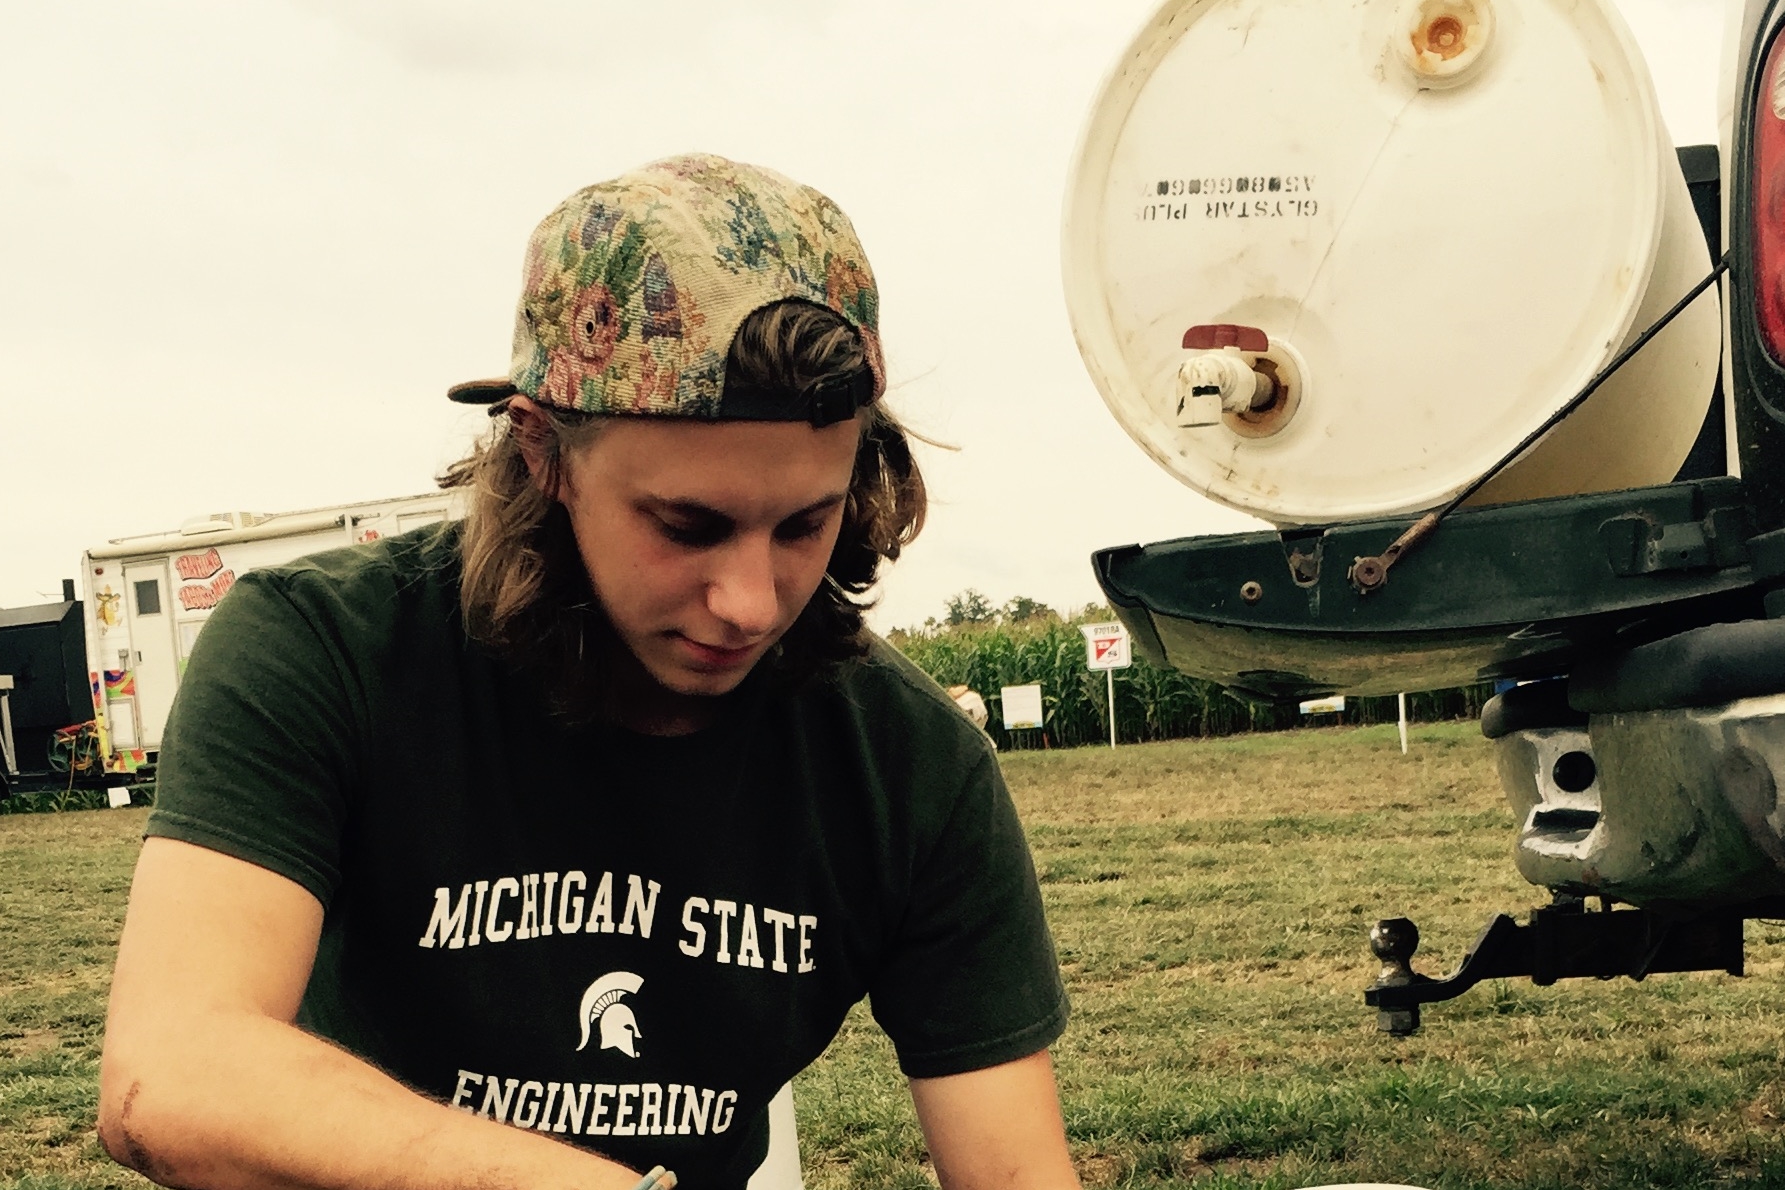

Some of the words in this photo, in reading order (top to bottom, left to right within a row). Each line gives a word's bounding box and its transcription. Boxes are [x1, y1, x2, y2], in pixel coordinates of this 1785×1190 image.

[1205, 200, 1318, 219] GLYSTAR
[418, 870, 662, 950] MICHIGAN
[678, 896, 818, 974] STATE
[451, 1069, 738, 1136] ENGINEERING
